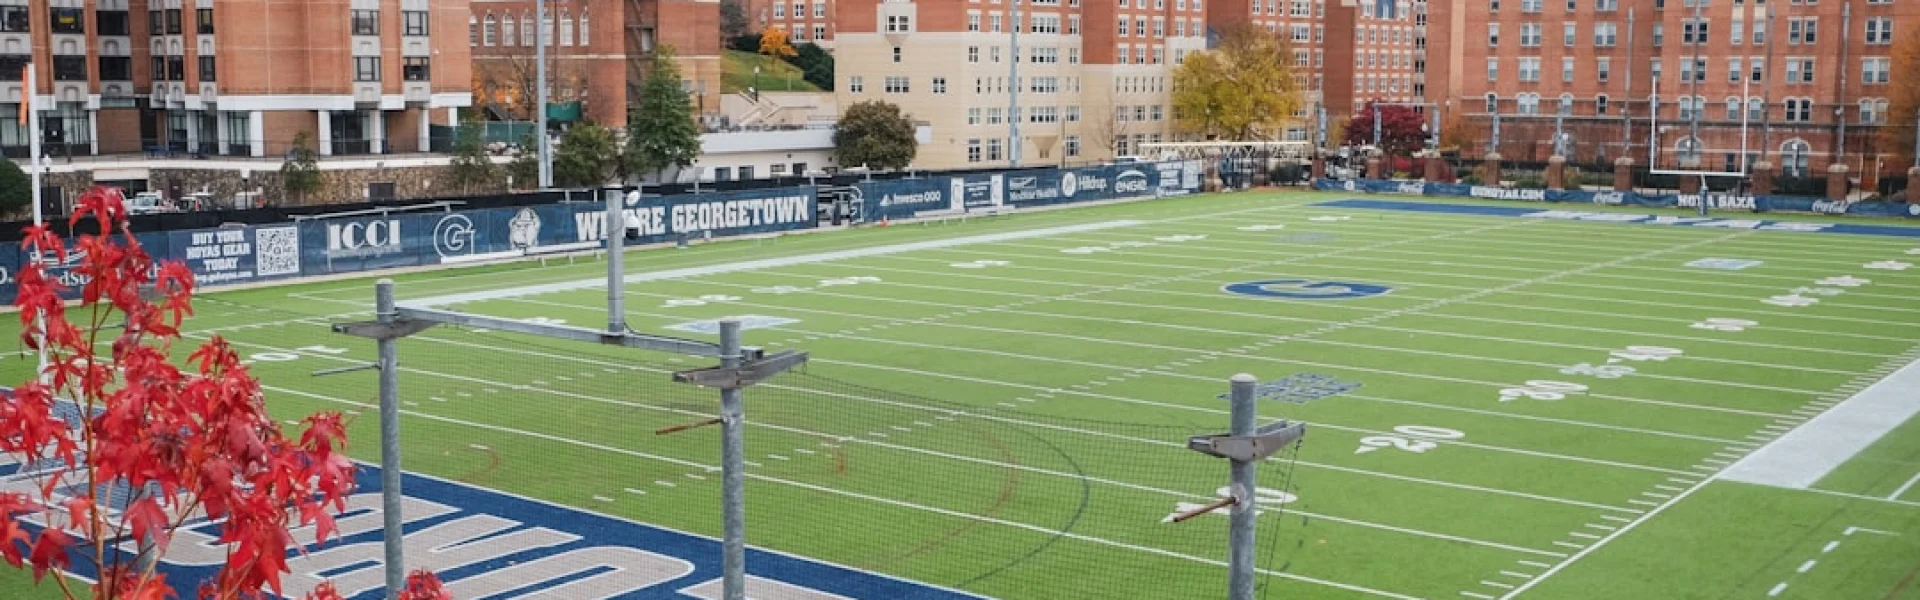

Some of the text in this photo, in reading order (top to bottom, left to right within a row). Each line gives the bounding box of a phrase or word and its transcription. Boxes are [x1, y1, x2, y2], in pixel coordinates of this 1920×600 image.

[672, 196, 810, 232] GEORGETOWN
[329, 219, 401, 250] ICCI
[203, 257, 238, 271] TODAY
[1360, 425, 1466, 453] 20
